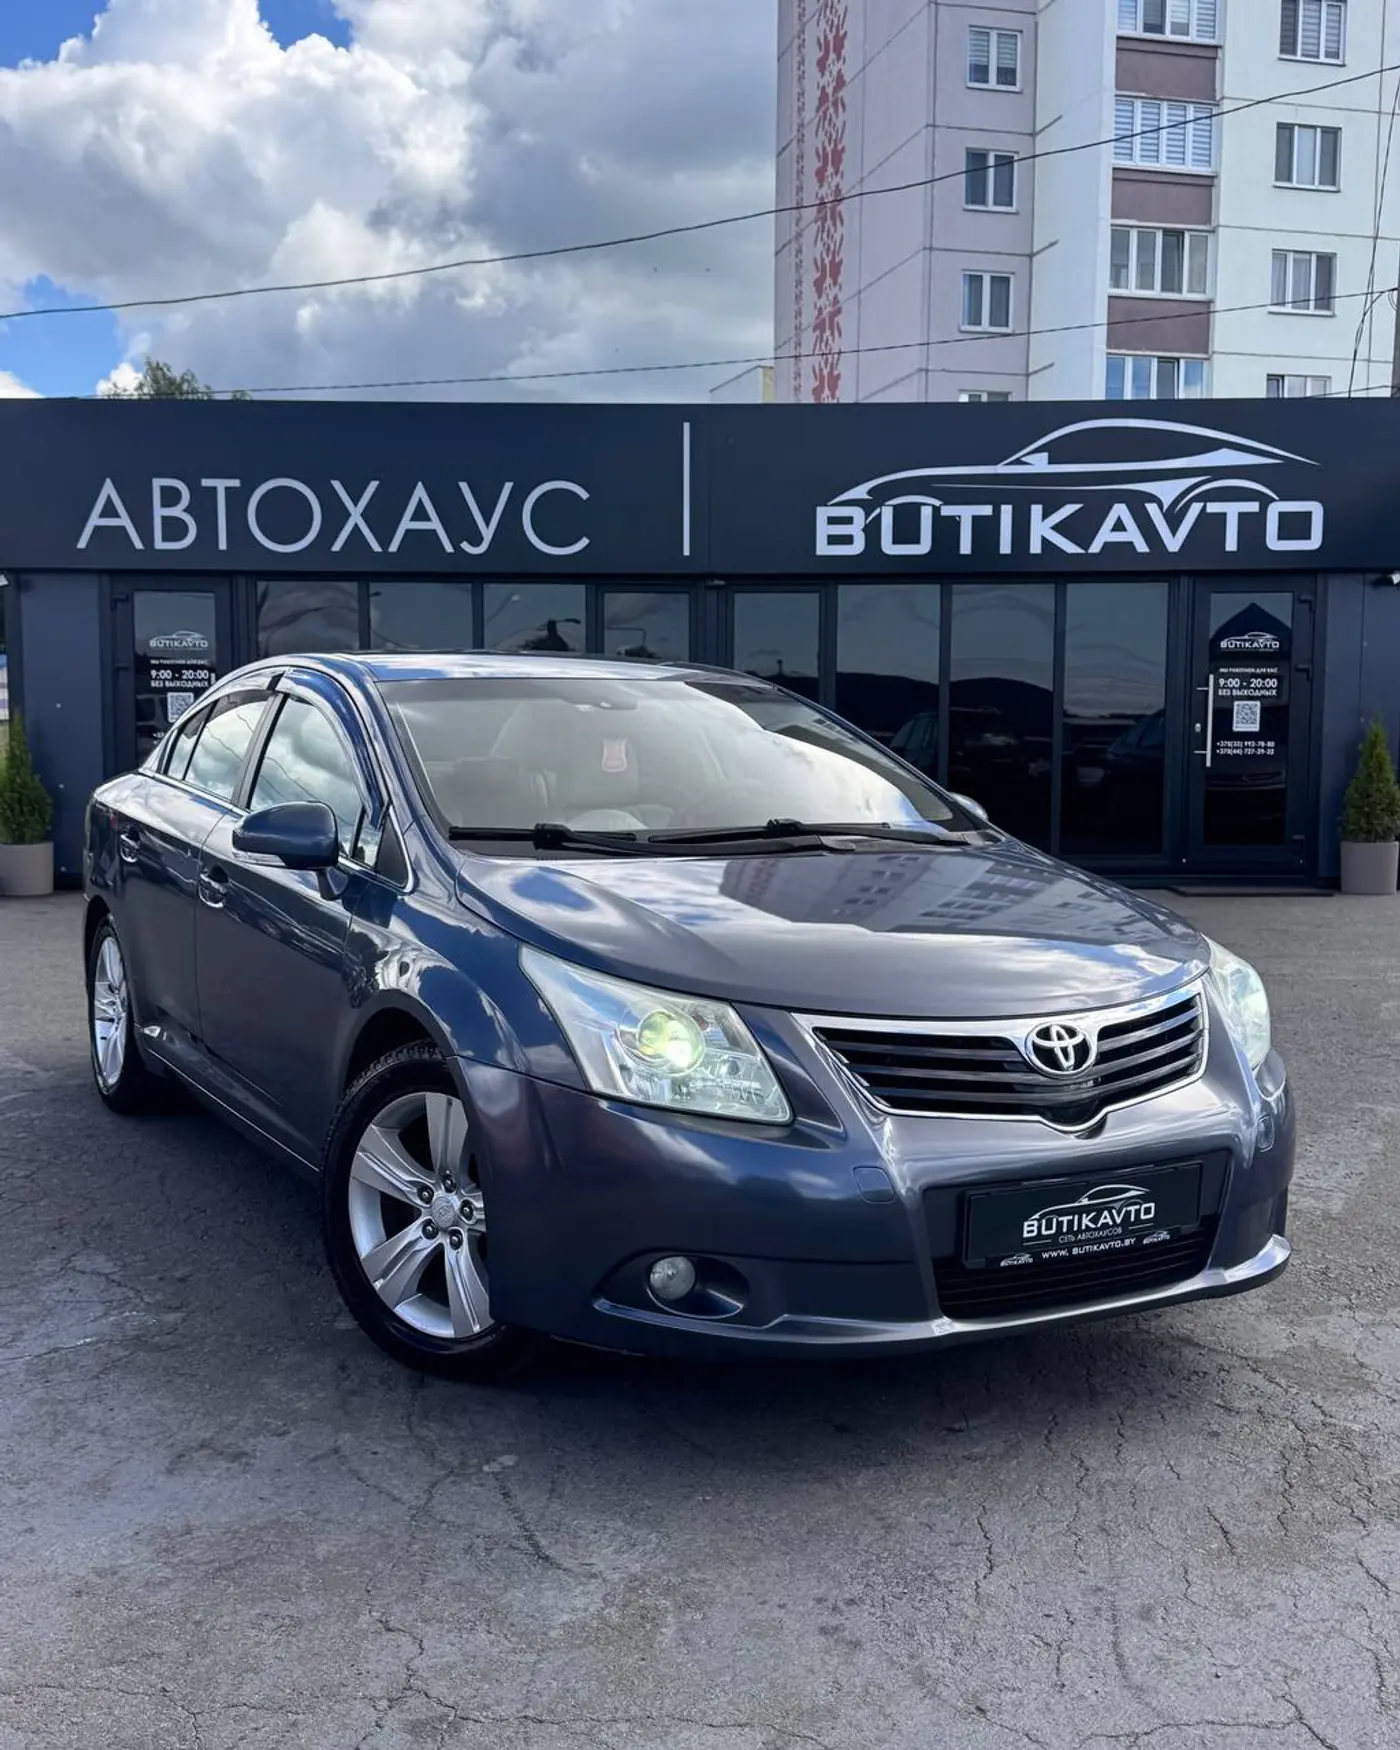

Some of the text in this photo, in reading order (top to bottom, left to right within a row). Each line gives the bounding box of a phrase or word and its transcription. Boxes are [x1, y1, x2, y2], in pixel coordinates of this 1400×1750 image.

[76, 477, 592, 556] АВТОХАУС
[815, 500, 1324, 557] BUTIKAVTO
[150, 669, 172, 680] 9:00
[181, 669, 209, 680] 20:00
[1218, 678, 1240, 688] 9:00
[1250, 678, 1278, 688] 20:00
[151, 680, 209, 688] БЕЗ ВЫХОДНЫХ
[1218, 688, 1277, 696] БЕЗ ВЫХОДНЫХ
[1022, 1202, 1156, 1239] BUTIKAVTO
[1058, 1226, 1123, 1244] СЕТЬ АВТОХАУСОВ
[1071, 1237, 1137, 1256] BUTIKAVTO.BY
